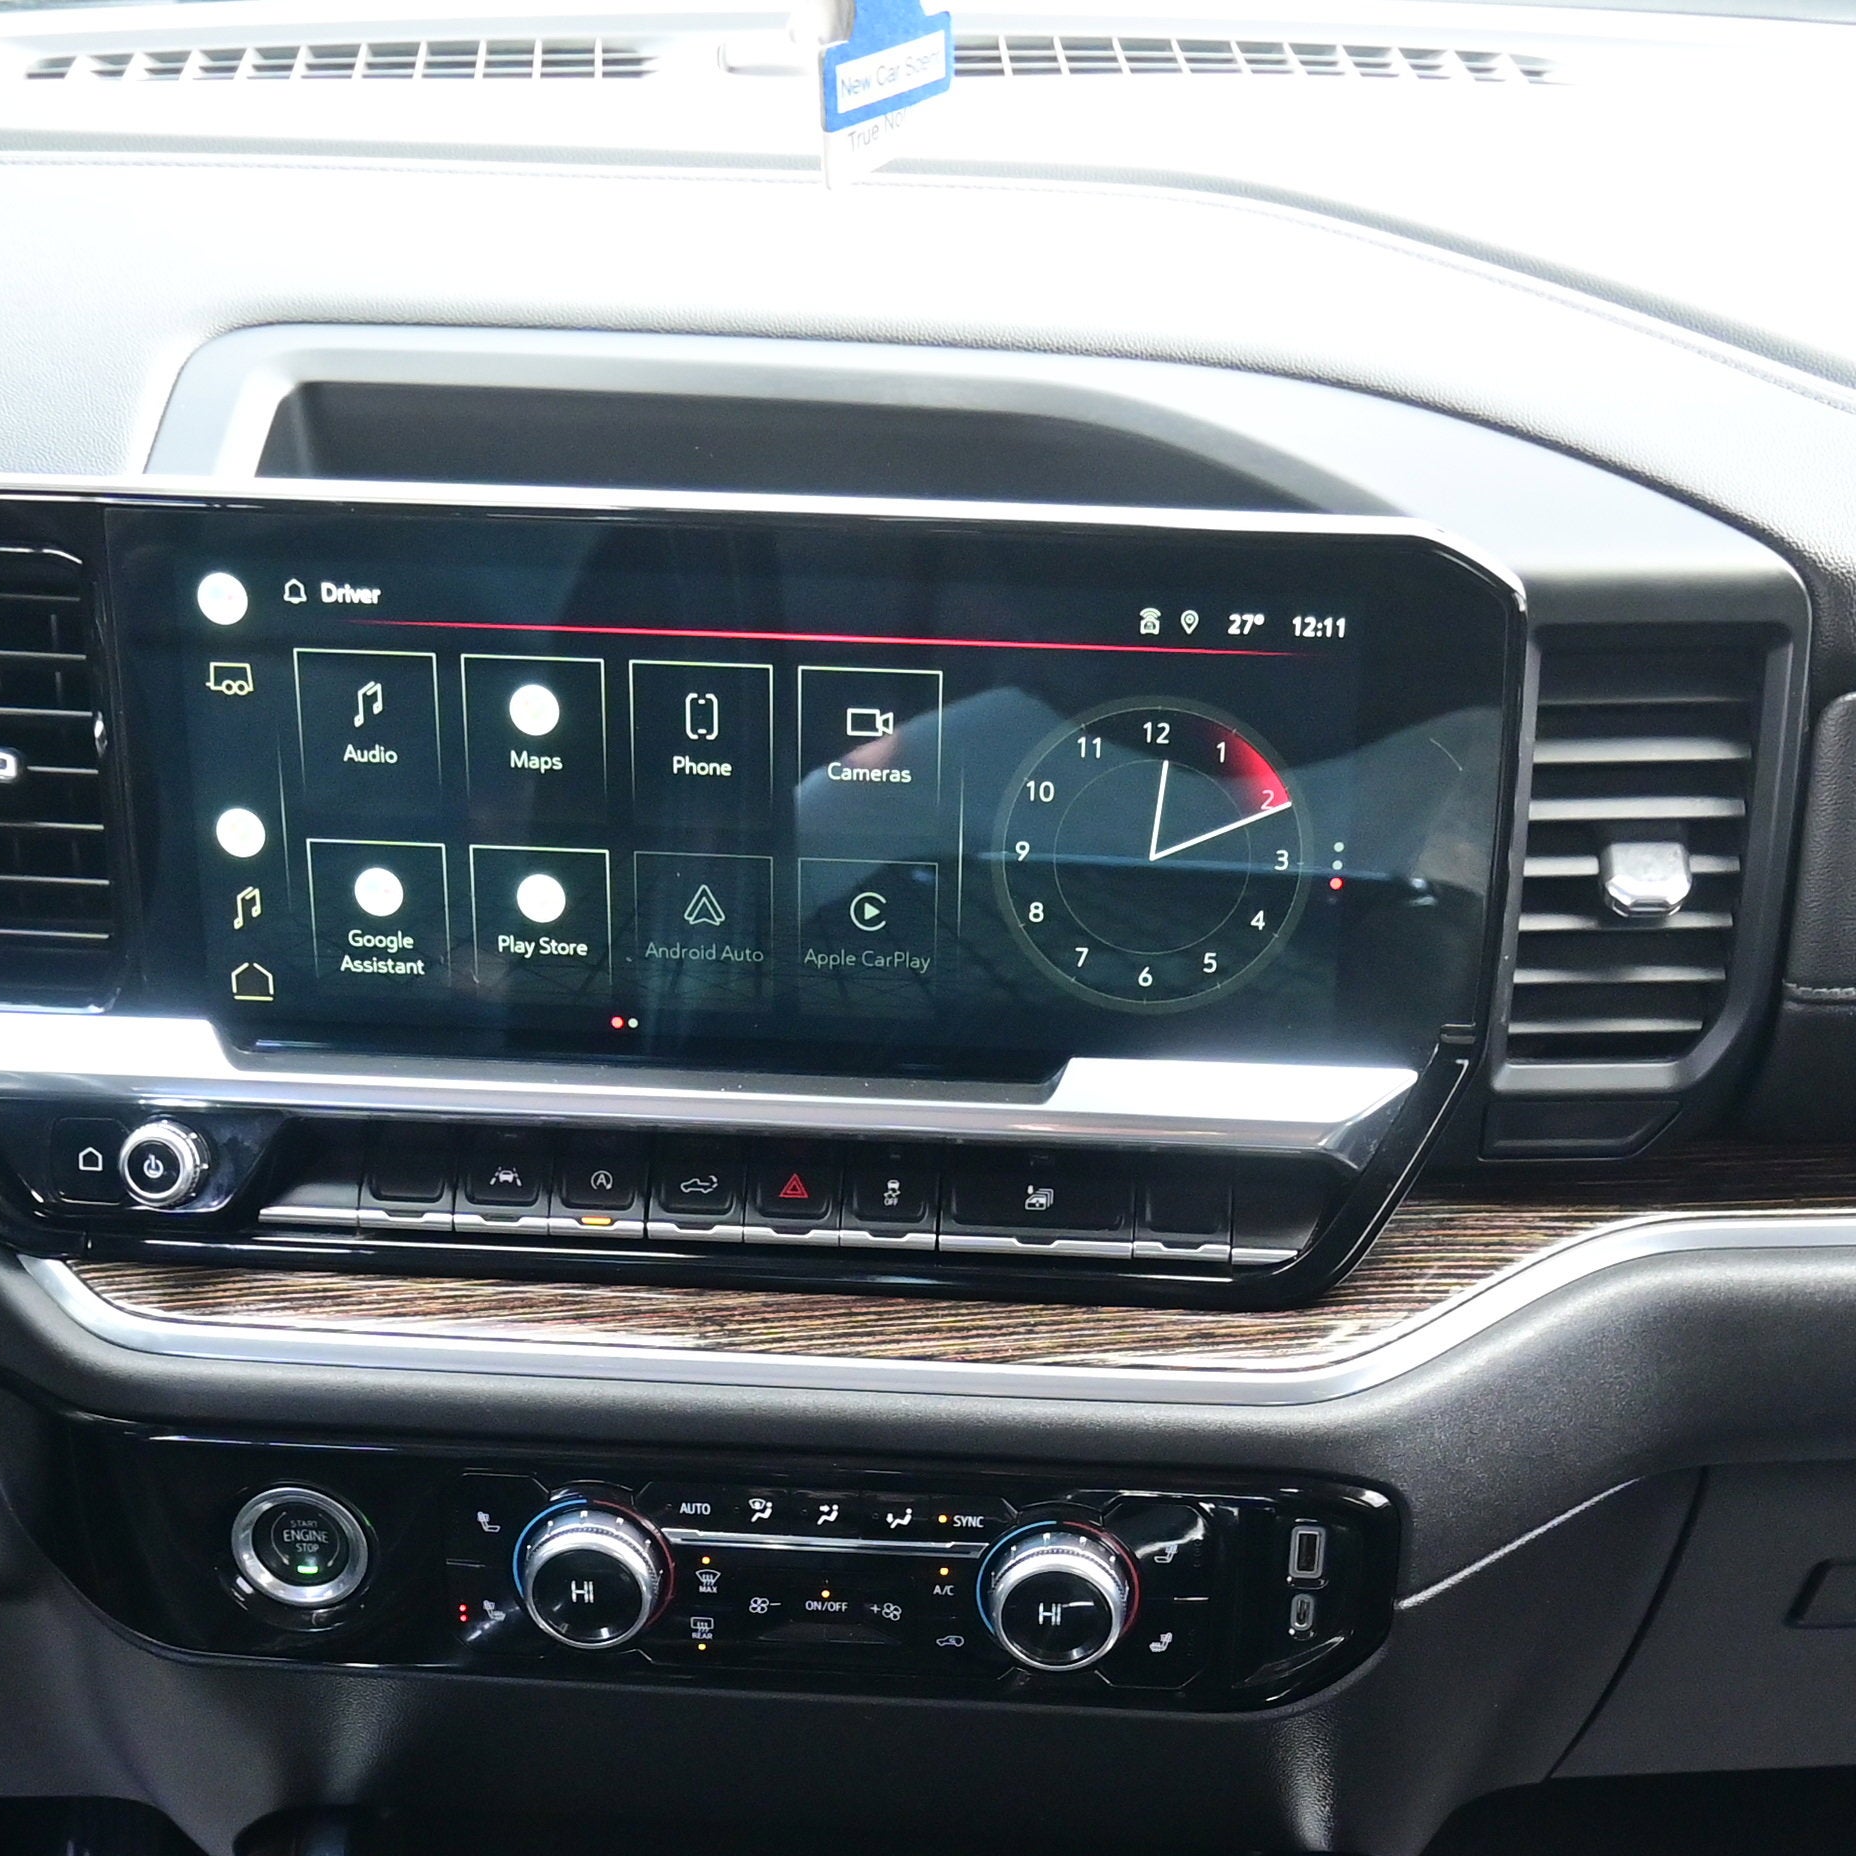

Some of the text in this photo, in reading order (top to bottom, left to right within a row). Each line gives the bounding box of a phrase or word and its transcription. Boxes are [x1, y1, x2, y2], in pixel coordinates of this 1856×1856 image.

[841, 76, 872, 98] New
[876, 64, 900, 86] Car
[848, 124, 880, 152] True
[320, 582, 381, 606] Driver
[1227, 613, 1346, 638] 27° 12:11
[1142, 722, 1170, 744] 12
[344, 744, 398, 765] Audio
[1076, 737, 1102, 758] 11
[1216, 742, 1227, 763] 1
[510, 750, 563, 774] Maps
[672, 757, 732, 778] Phone
[827, 762, 912, 784] Cameras
[1025, 781, 1055, 802] 10
[1261, 789, 1274, 810] 2
[1015, 841, 1030, 862] 9
[1275, 851, 1289, 871] 3
[1029, 902, 1044, 923] 8
[1250, 910, 1266, 931] 4
[348, 929, 415, 953] Google
[497, 935, 588, 958] Play Store
[645, 941, 764, 964] Android Auto
[804, 948, 930, 973] Apple CarPlay
[1075, 948, 1088, 968] 7
[340, 955, 425, 977] Assistant
[1203, 953, 1218, 974] 5
[1138, 966, 1153, 988] 6
[679, 1502, 711, 1515] AUTO
[290, 1519, 318, 1528] START
[953, 1514, 984, 1529] SYNC
[283, 1529, 329, 1544] ENGINE
[295, 1543, 320, 1553] STOP
[571, 1580, 595, 1604] HI
[698, 1585, 718, 1594] MAX
[933, 1583, 954, 1598] A/C
[805, 1599, 849, 1613] ON/OFF
[1039, 1603, 1062, 1625] HI
[691, 1631, 713, 1640] REAR
